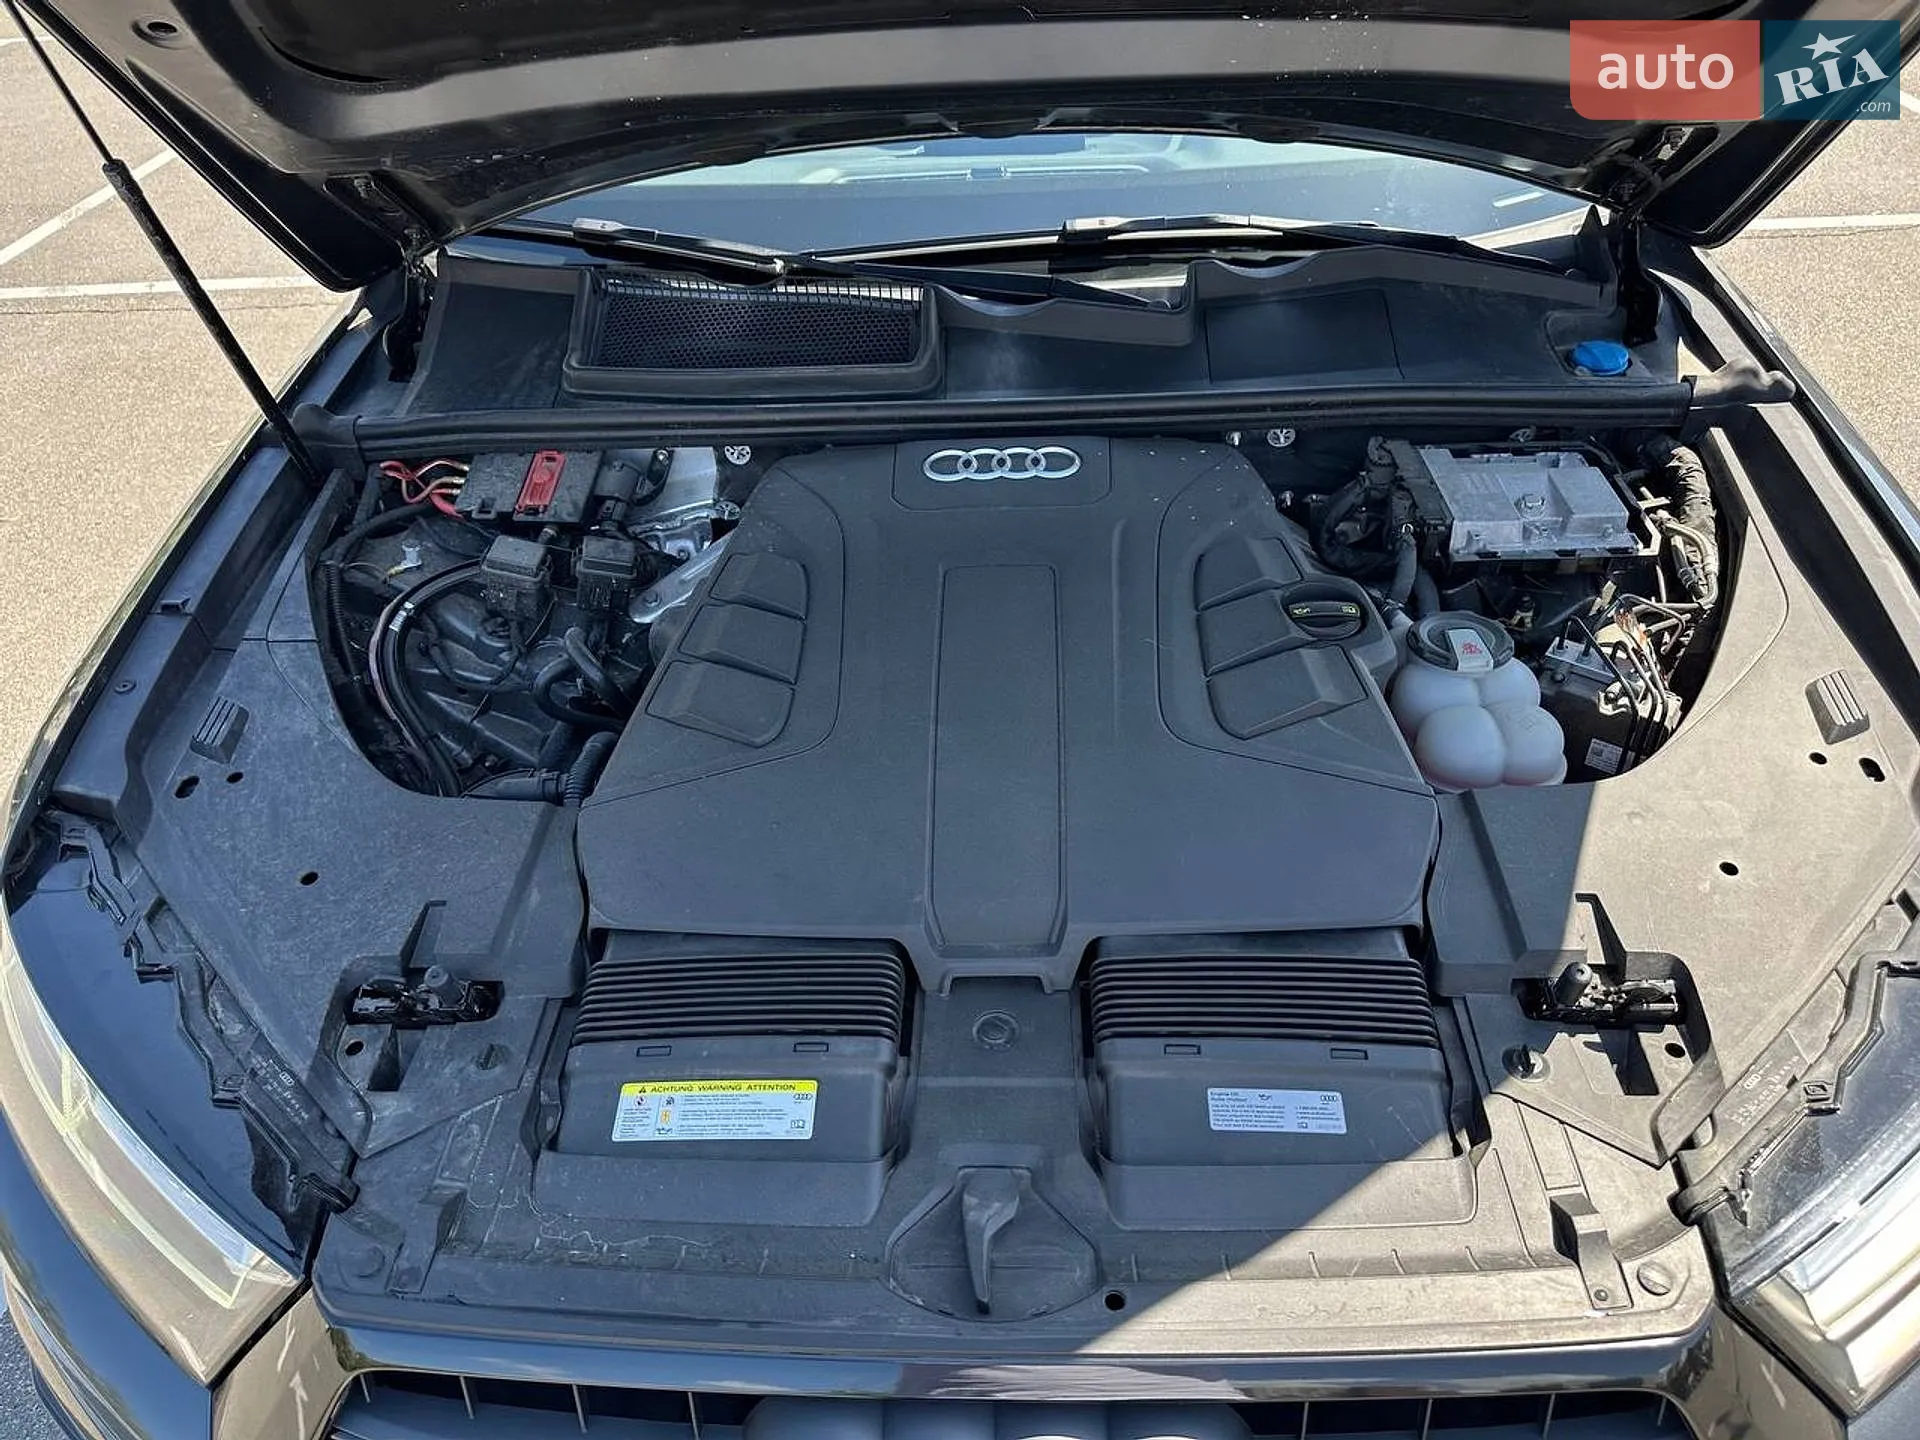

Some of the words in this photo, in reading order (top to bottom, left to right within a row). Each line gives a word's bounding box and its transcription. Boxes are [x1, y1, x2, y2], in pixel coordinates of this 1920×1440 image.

[651, 1085, 693, 1093] ACHTUNG
[698, 1084, 742, 1092] WARNING
[746, 1083, 796, 1091] ATTENTION
